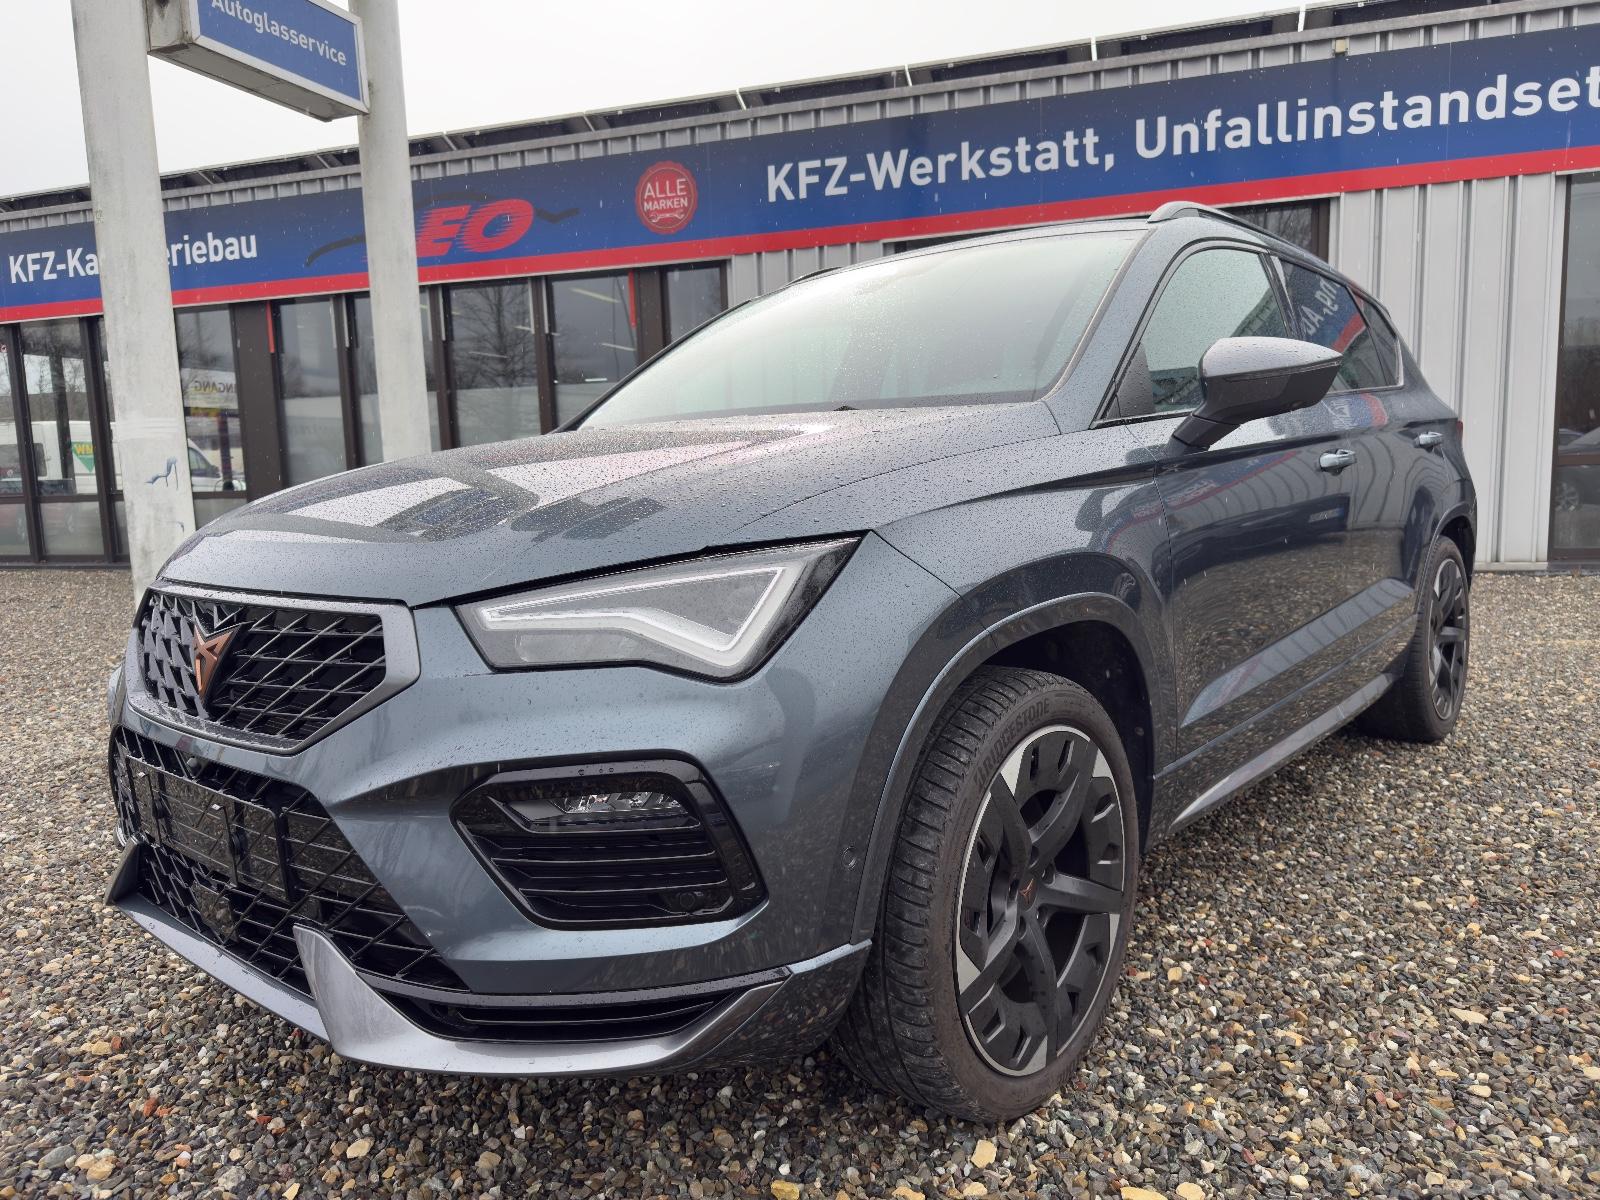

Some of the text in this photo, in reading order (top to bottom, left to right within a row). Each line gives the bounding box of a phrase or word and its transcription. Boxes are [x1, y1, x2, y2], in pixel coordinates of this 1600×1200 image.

[211, 0, 347, 66] Autoglasservice
[767, 65, 1600, 203] KFZ-Werkstatt, Unfallinstandset
[643, 197, 688, 211] MARKEN
[644, 178, 687, 199] ALLE
[415, 199, 533, 258] EO
